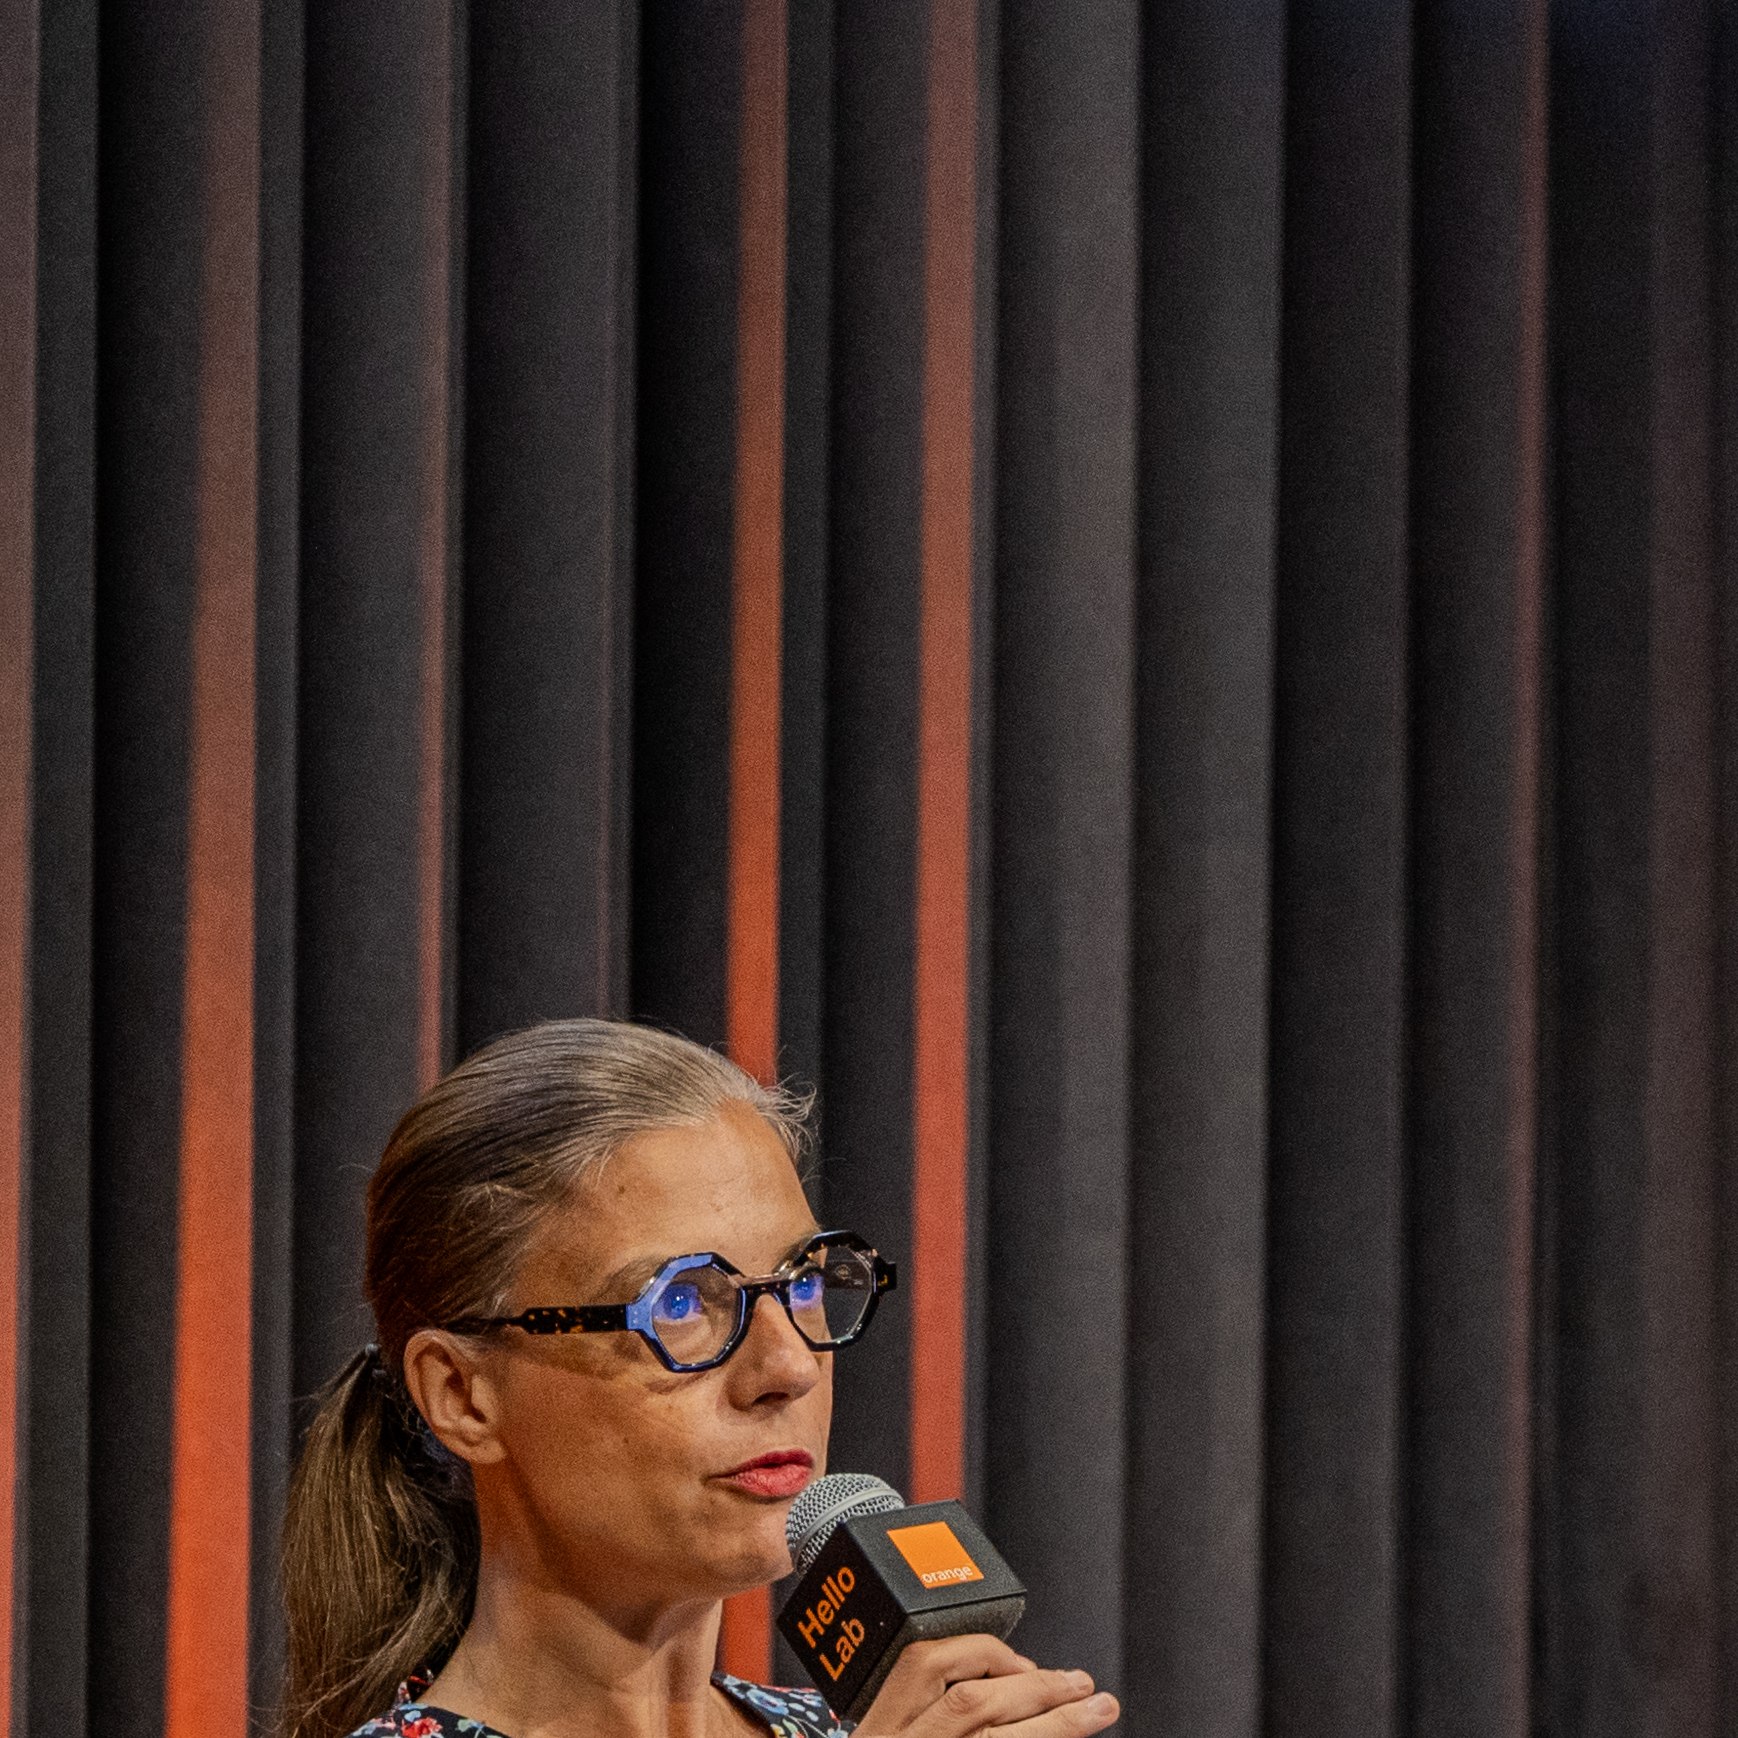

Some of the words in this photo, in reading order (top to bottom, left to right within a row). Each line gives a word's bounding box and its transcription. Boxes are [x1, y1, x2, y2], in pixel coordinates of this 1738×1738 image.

[921, 1564, 974, 1583] orange
[797, 1566, 855, 1649] Hello
[819, 1618, 865, 1681] Lab
